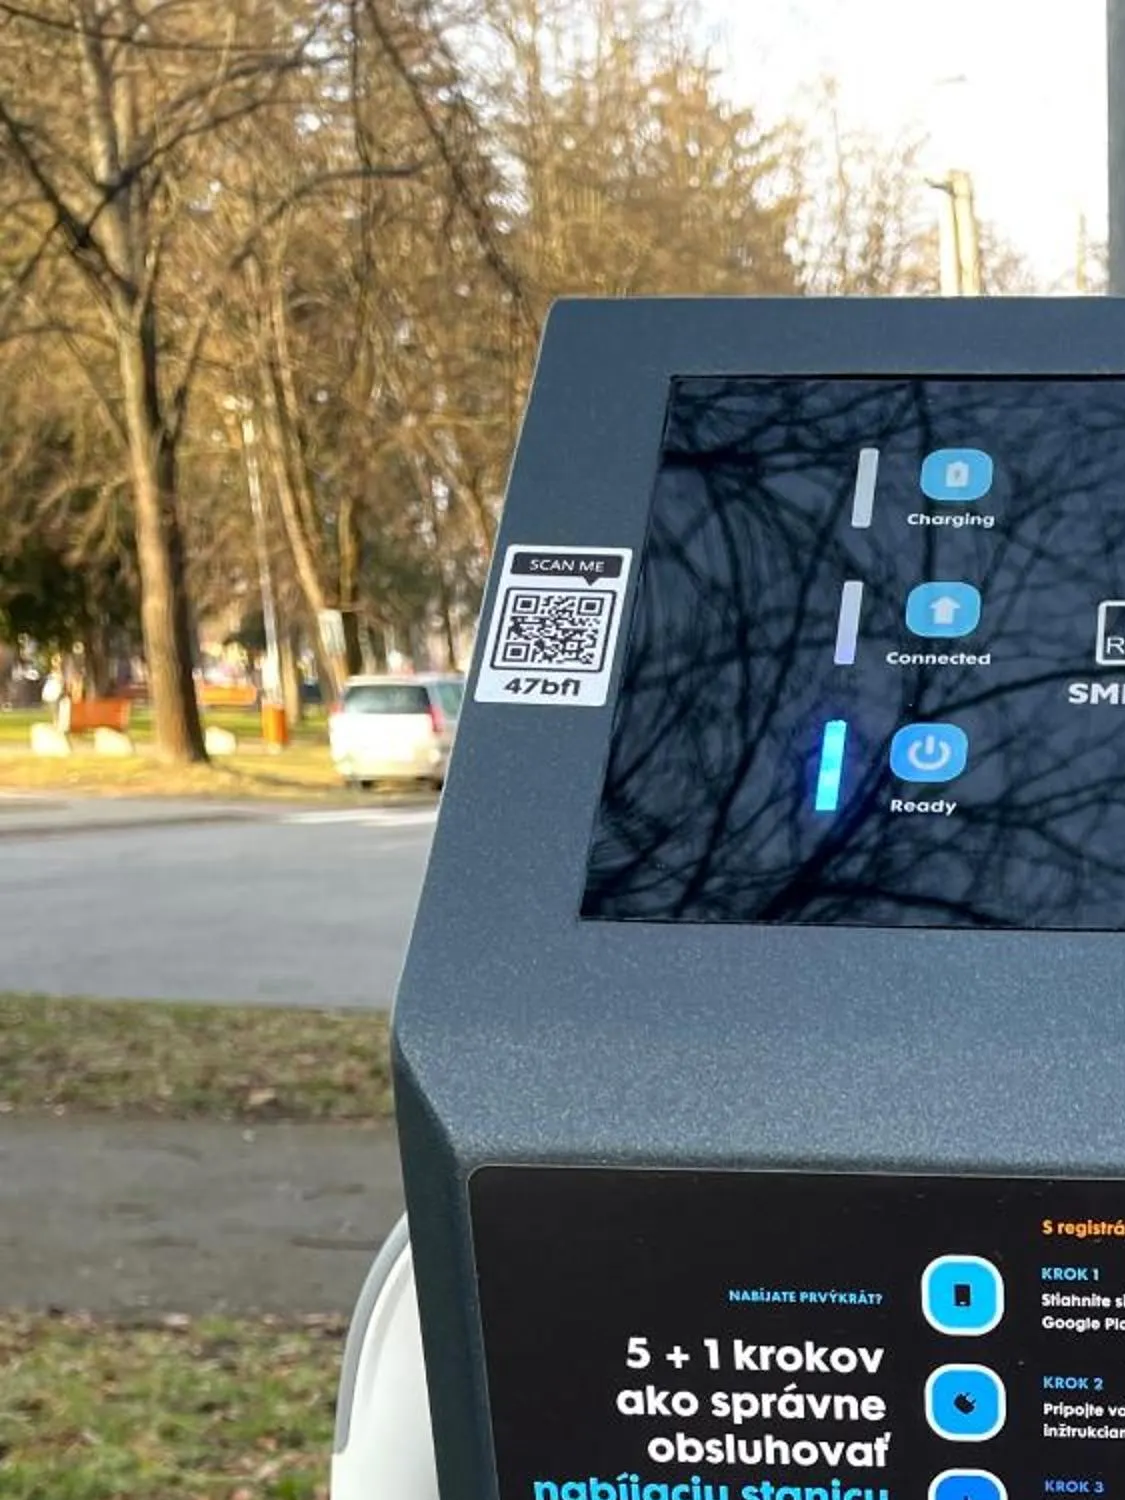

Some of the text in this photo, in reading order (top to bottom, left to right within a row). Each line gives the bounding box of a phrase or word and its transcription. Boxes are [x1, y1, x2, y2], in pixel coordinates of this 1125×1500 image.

[906, 512, 996, 529] Charging
[529, 558, 605, 573] SCAN ME
[885, 650, 992, 666] Connected
[889, 798, 958, 817] Ready
[1042, 1218, 1054, 1235] S
[1041, 1266, 1100, 1282] KROK 1
[1041, 1291, 1112, 1308] Stiahnite
[1041, 1315, 1101, 1334] Google
[626, 1336, 885, 1374] 5 + 1 krokov
[1042, 1375, 1104, 1391] KROK 2
[615, 1384, 700, 1418] ako
[1044, 1479, 1105, 1494] KROK 3
